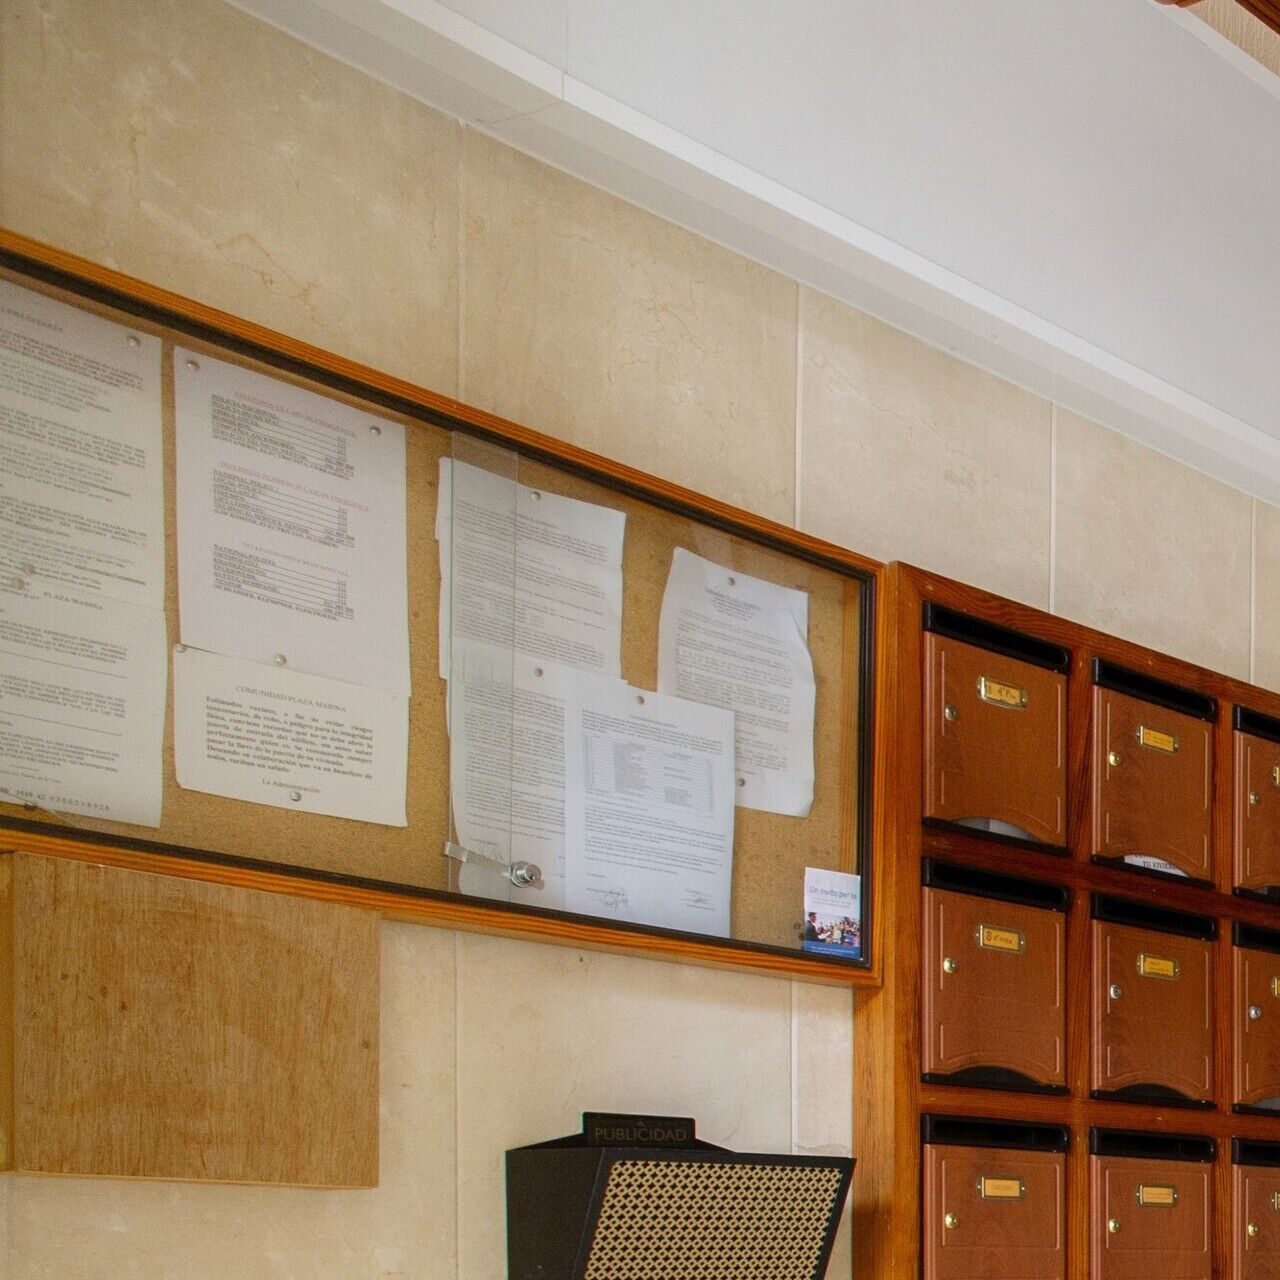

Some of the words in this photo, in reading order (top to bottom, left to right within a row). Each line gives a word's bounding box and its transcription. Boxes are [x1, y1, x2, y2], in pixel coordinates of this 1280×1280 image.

[235, 686, 287, 700] COMUNIDAD
[288, 695, 314, 707] PLAZA
[315, 701, 346, 713] MARINA
[206, 696, 243, 708] Estimados
[325, 720, 345, 728] evitar
[351, 724, 373, 734] riesgos
[207, 721, 230, 731] puerta
[246, 730, 274, 740] entrada
[263, 724, 293, 733] recordar
[348, 740, 364, 748] abrir
[206, 729, 257, 742] perfectamente
[306, 748, 344, 759] recomienda
[346, 755, 373, 764] siempre
[236, 742, 253, 750] llave
[272, 750, 296, 759] puerta
[206, 744, 241, 756] Deseando
[333, 767, 363, 778] beneficio
[809, 886, 819, 894] Un
[820, 888, 839, 898] invito
[839, 891, 850, 899] per
[595, 1126, 687, 1141] PUBLICIDAD
